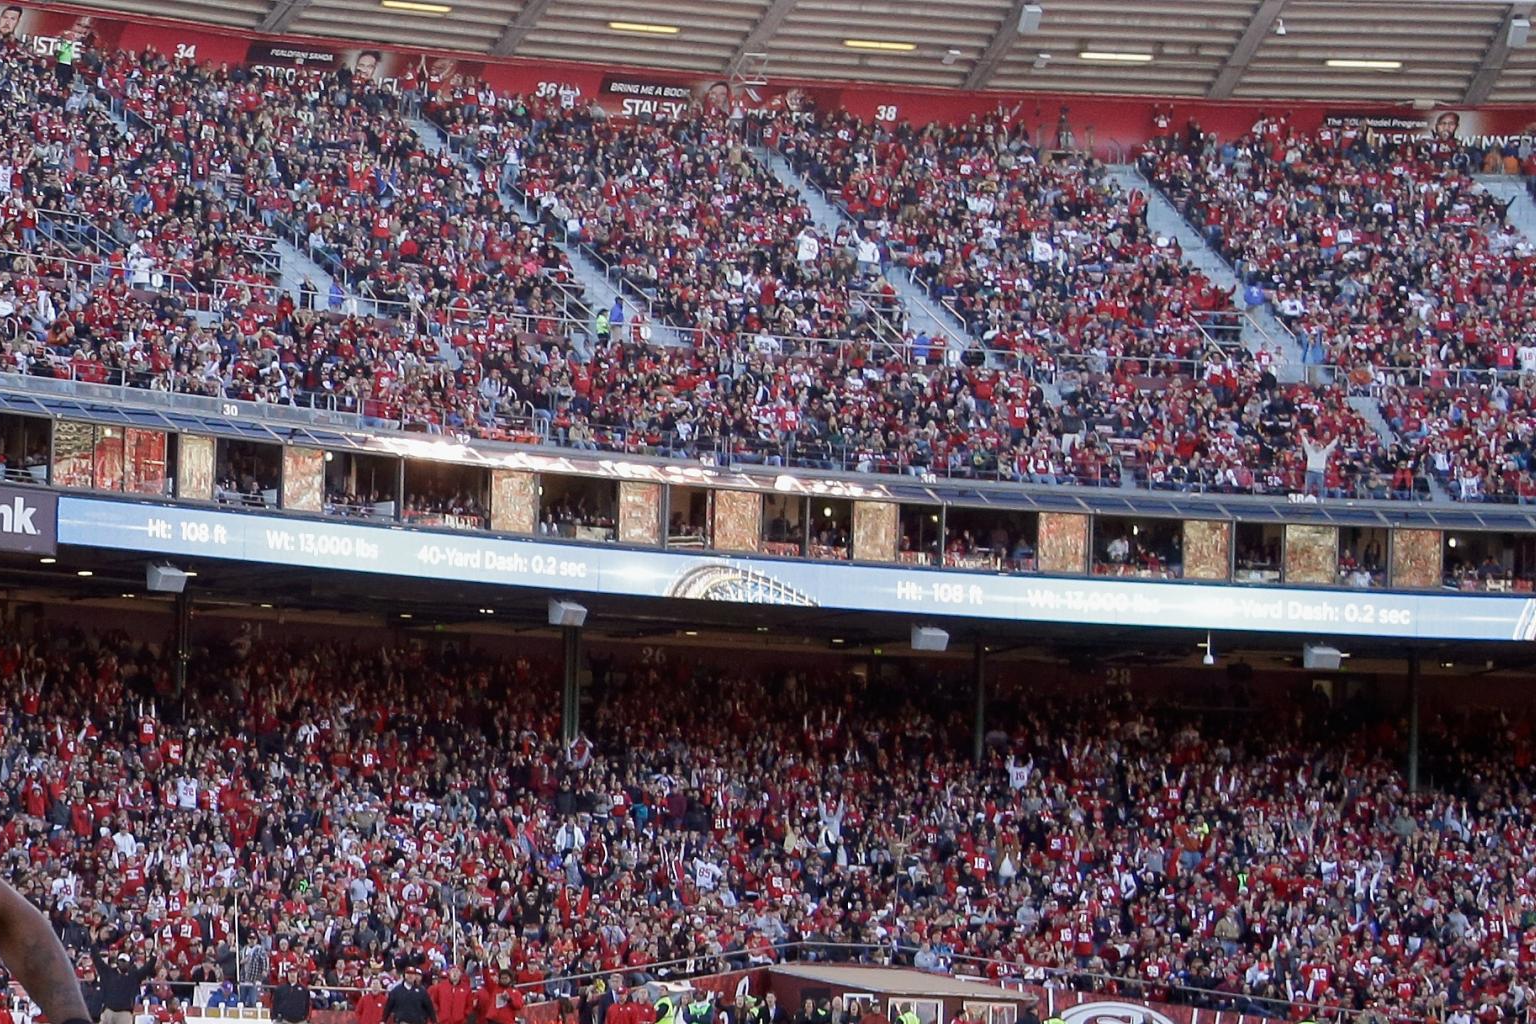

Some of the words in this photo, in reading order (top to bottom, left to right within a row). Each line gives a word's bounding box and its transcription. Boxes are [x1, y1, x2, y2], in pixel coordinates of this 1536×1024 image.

[174, 44, 196, 59] 34
[535, 82, 558, 98] 36
[610, 82, 639, 95] BRING
[640, 85, 657, 95] ME
[654, 88, 662, 96] A
[876, 105, 897, 121] 38
[1327, 118, 1342, 126] The
[1441, 311, 1449, 321] 15
[222, 404, 237, 416] 30
[147, 518, 172, 539] Ht:
[180, 521, 209, 543] 108
[213, 523, 227, 544] ft
[266, 529, 294, 550] Wt:
[299, 533, 353, 556] 13,000
[355, 538, 379, 559] lbs
[417, 544, 479, 569] 40-Yard
[484, 551, 527, 573] Dash:
[532, 554, 557, 575] 0.2
[560, 560, 587, 578] sec
[896, 581, 922, 601] Ht:
[932, 583, 962, 603] 108
[969, 585, 983, 605] ft
[1287, 600, 1339, 621] Dash:
[1344, 603, 1373, 623] 0.2
[1378, 607, 1411, 625] sec
[641, 646, 666, 665] 26
[1106, 668, 1131, 685] 28
[715, 818, 724, 829] 21
[974, 857, 985, 869] 16
[180, 924, 192, 937] 21
[1024, 966, 1045, 980] 24
